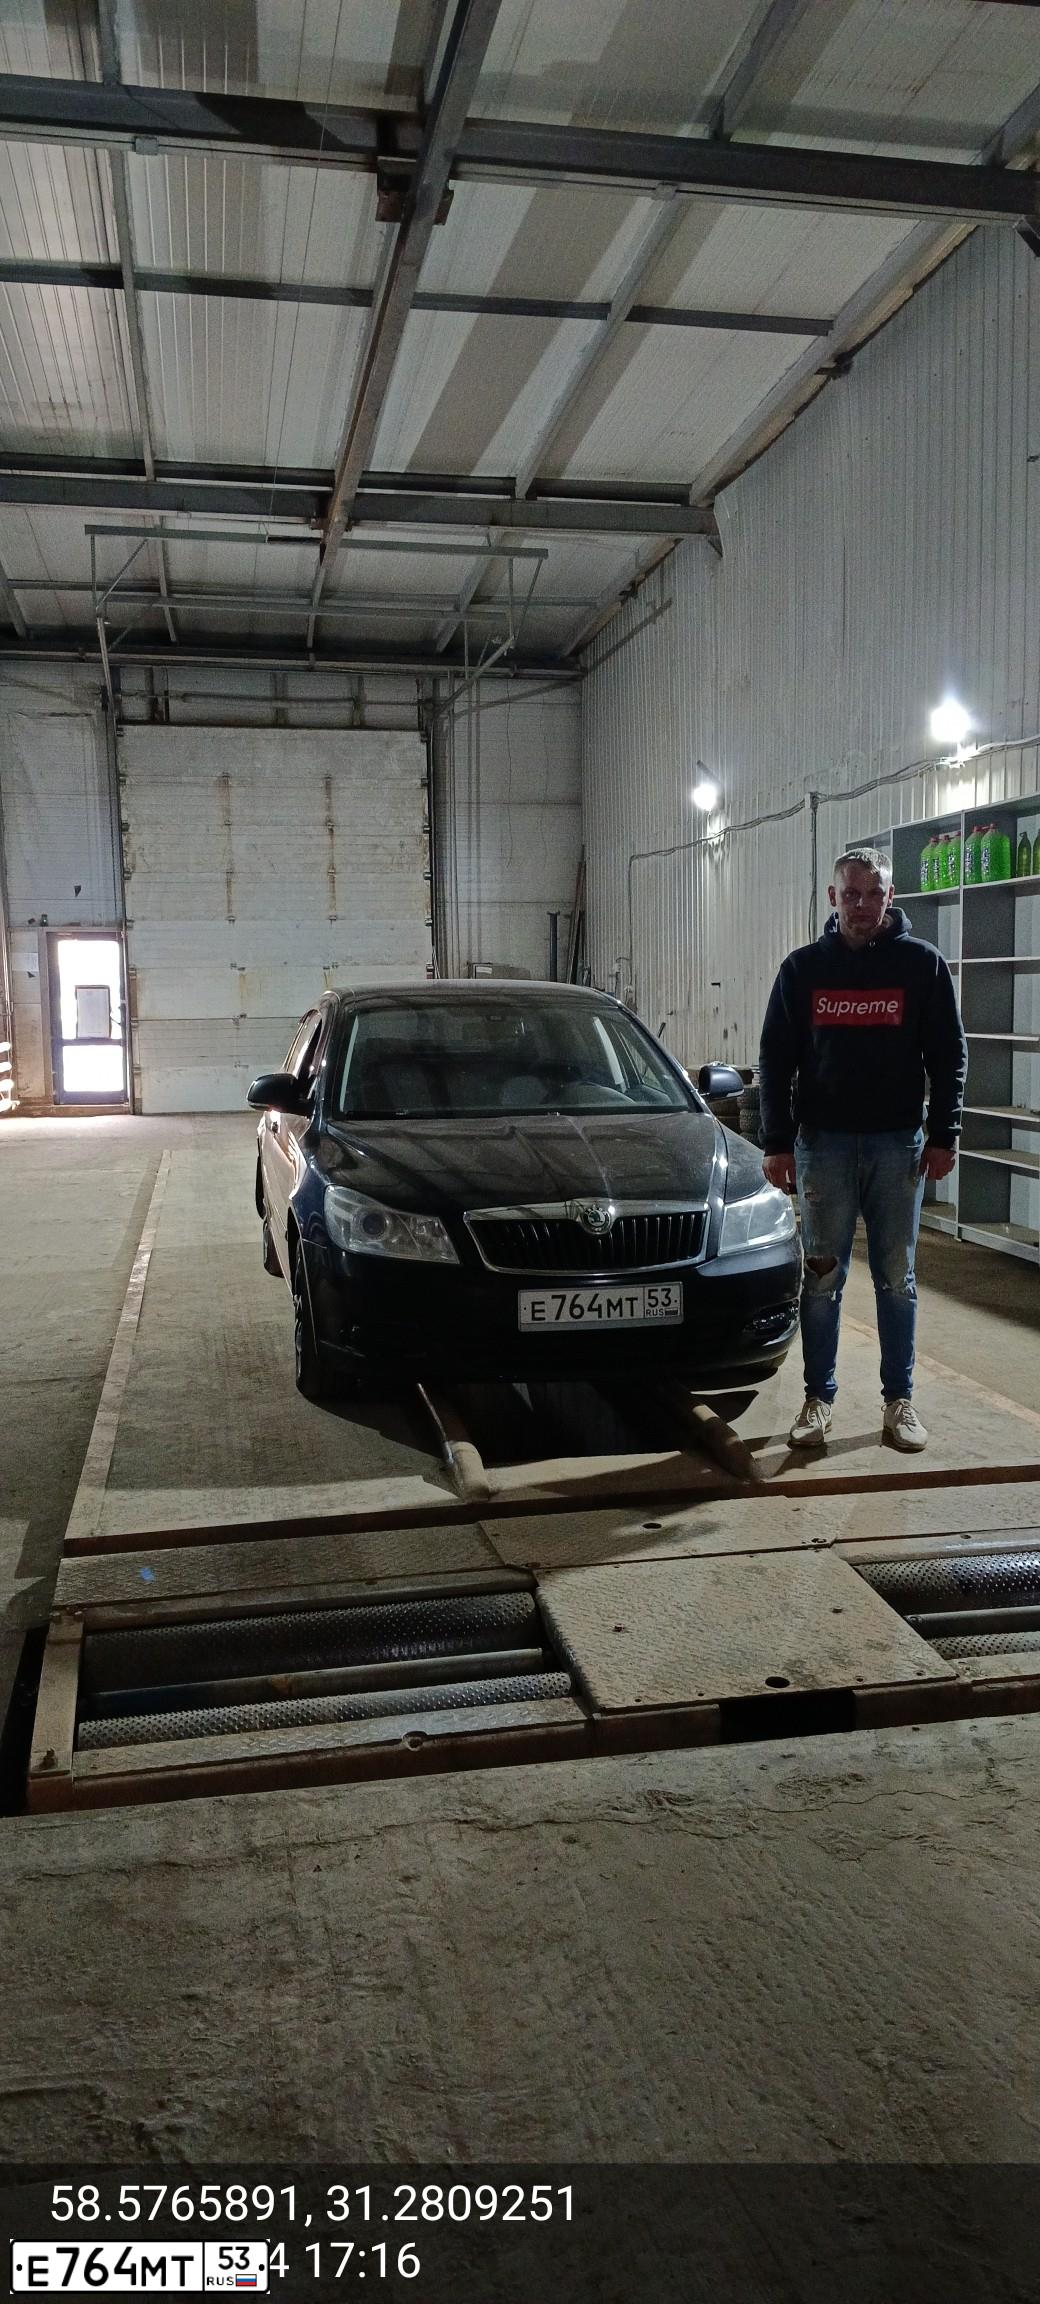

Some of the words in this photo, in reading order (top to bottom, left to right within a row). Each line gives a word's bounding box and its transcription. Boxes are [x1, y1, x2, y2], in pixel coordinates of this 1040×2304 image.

[816, 997, 899, 1017] Supreme
[647, 1287, 672, 1308] 53
[645, 1308, 664, 1317] RUS
